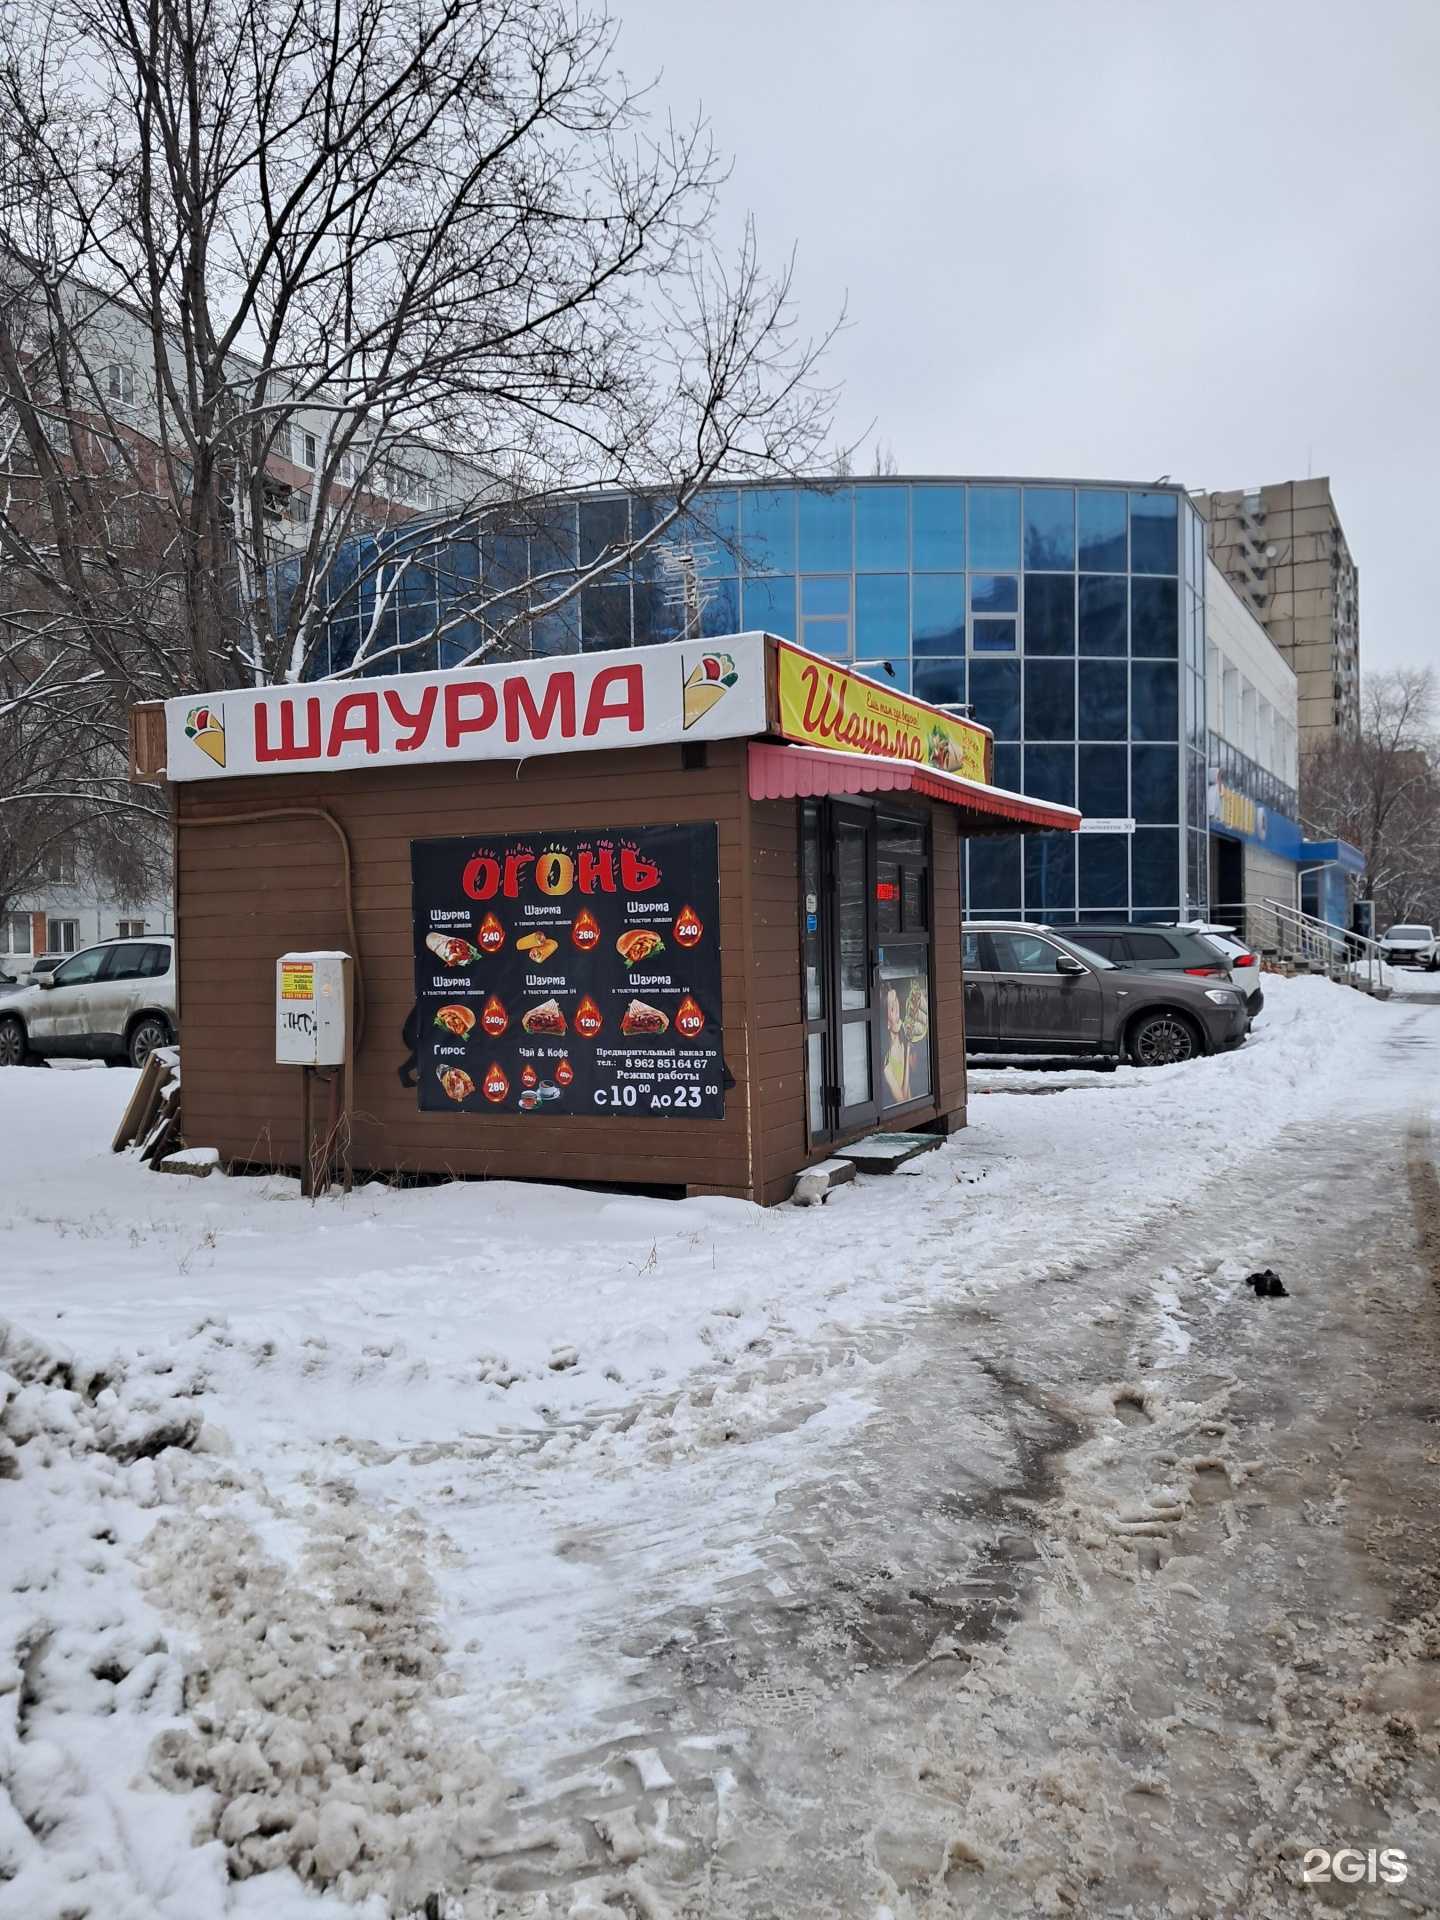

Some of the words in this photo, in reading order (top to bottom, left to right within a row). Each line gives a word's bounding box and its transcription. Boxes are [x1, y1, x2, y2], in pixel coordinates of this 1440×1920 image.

[254, 663, 644, 763] ШАУРМА
[801, 664, 924, 764] Шаурма
[524, 905, 562, 916] Шаурма
[626, 901, 669, 913] Шаурма
[430, 909, 471, 921] Шаурма
[679, 925, 698, 936] 240
[482, 931, 500, 943] 240
[432, 976, 471, 988] Шаурма
[525, 974, 566, 987] Шаурма
[629, 973, 672, 986] Шаурма
[681, 1017, 700, 1028] 130
[433, 1044, 466, 1056] Гирос
[518, 1047, 535, 1057] Чай
[537, 1047, 545, 1057] &
[547, 1048, 569, 1058] Кофе
[625, 1059, 632, 1068] 8
[634, 1059, 655, 1068] 962
[693, 1059, 708, 1069] 67
[616, 1070, 655, 1080] Режим
[657, 1070, 700, 1082] работы
[487, 1081, 505, 1093] 280
[673, 1086, 702, 1107] 23
[705, 1085, 718, 1095] 00
